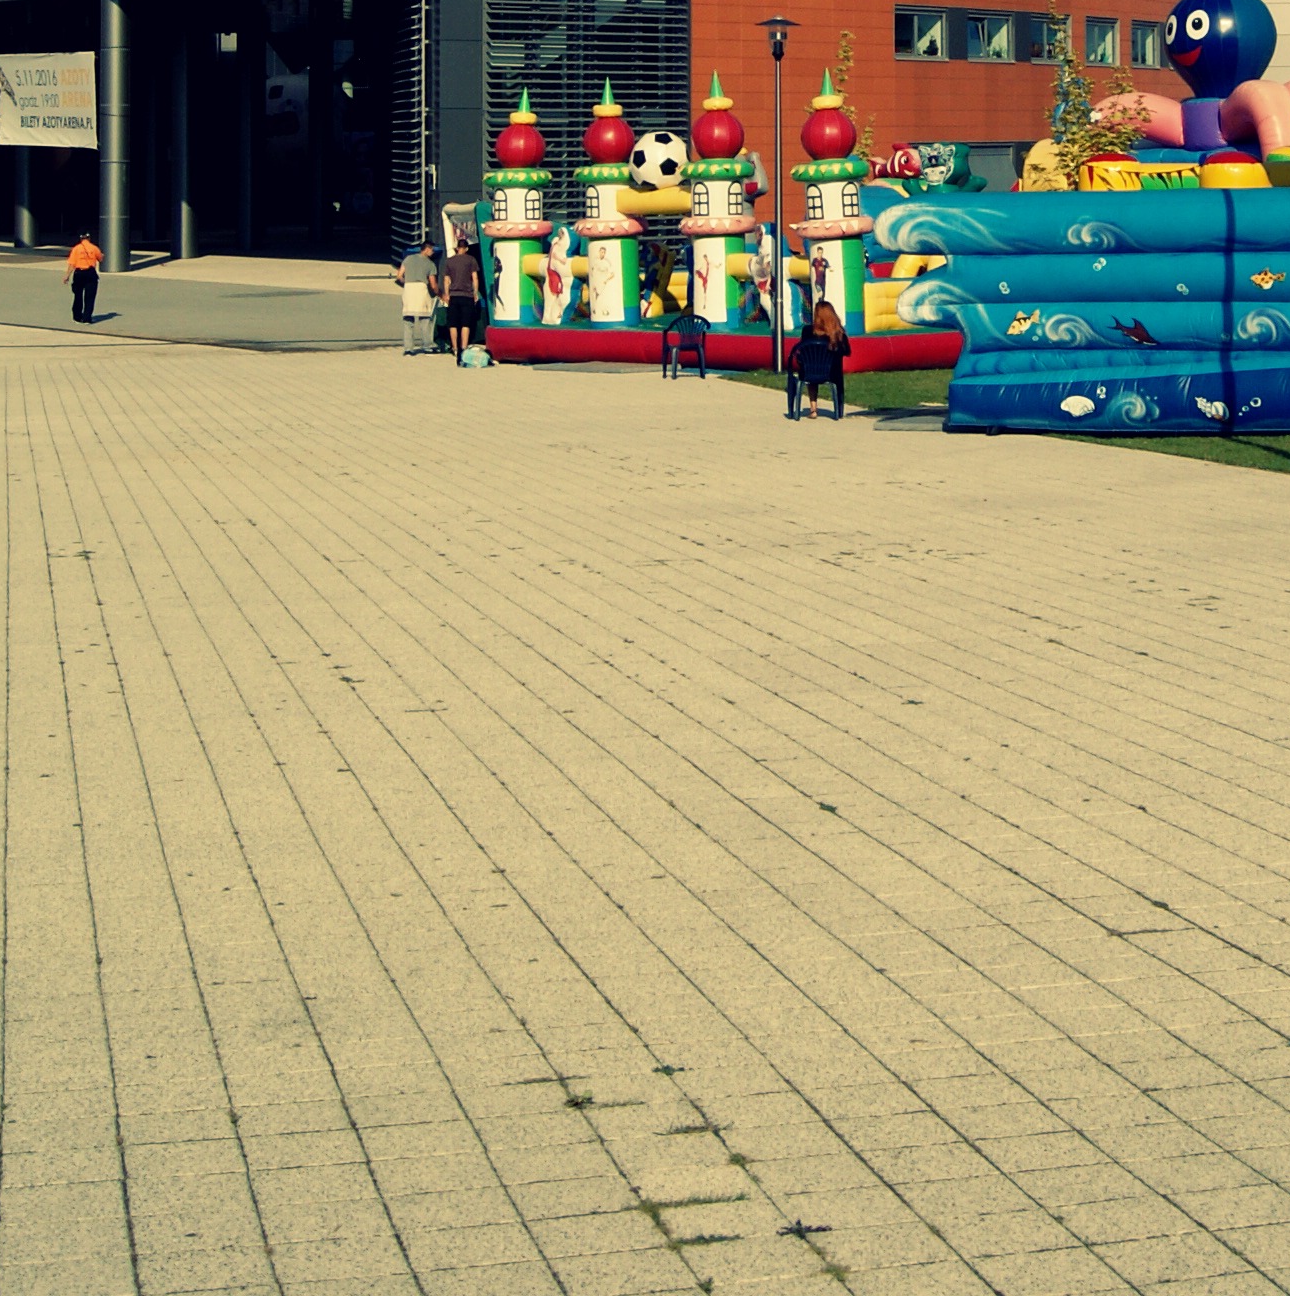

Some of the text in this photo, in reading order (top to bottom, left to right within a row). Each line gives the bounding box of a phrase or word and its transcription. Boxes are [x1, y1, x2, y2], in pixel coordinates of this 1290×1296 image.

[15, 68, 90, 86] 5.11.2016 AZOTY
[62, 91, 93, 108] ARENA
[20, 115, 94, 130] BILETY AZOTYARENA.PL
